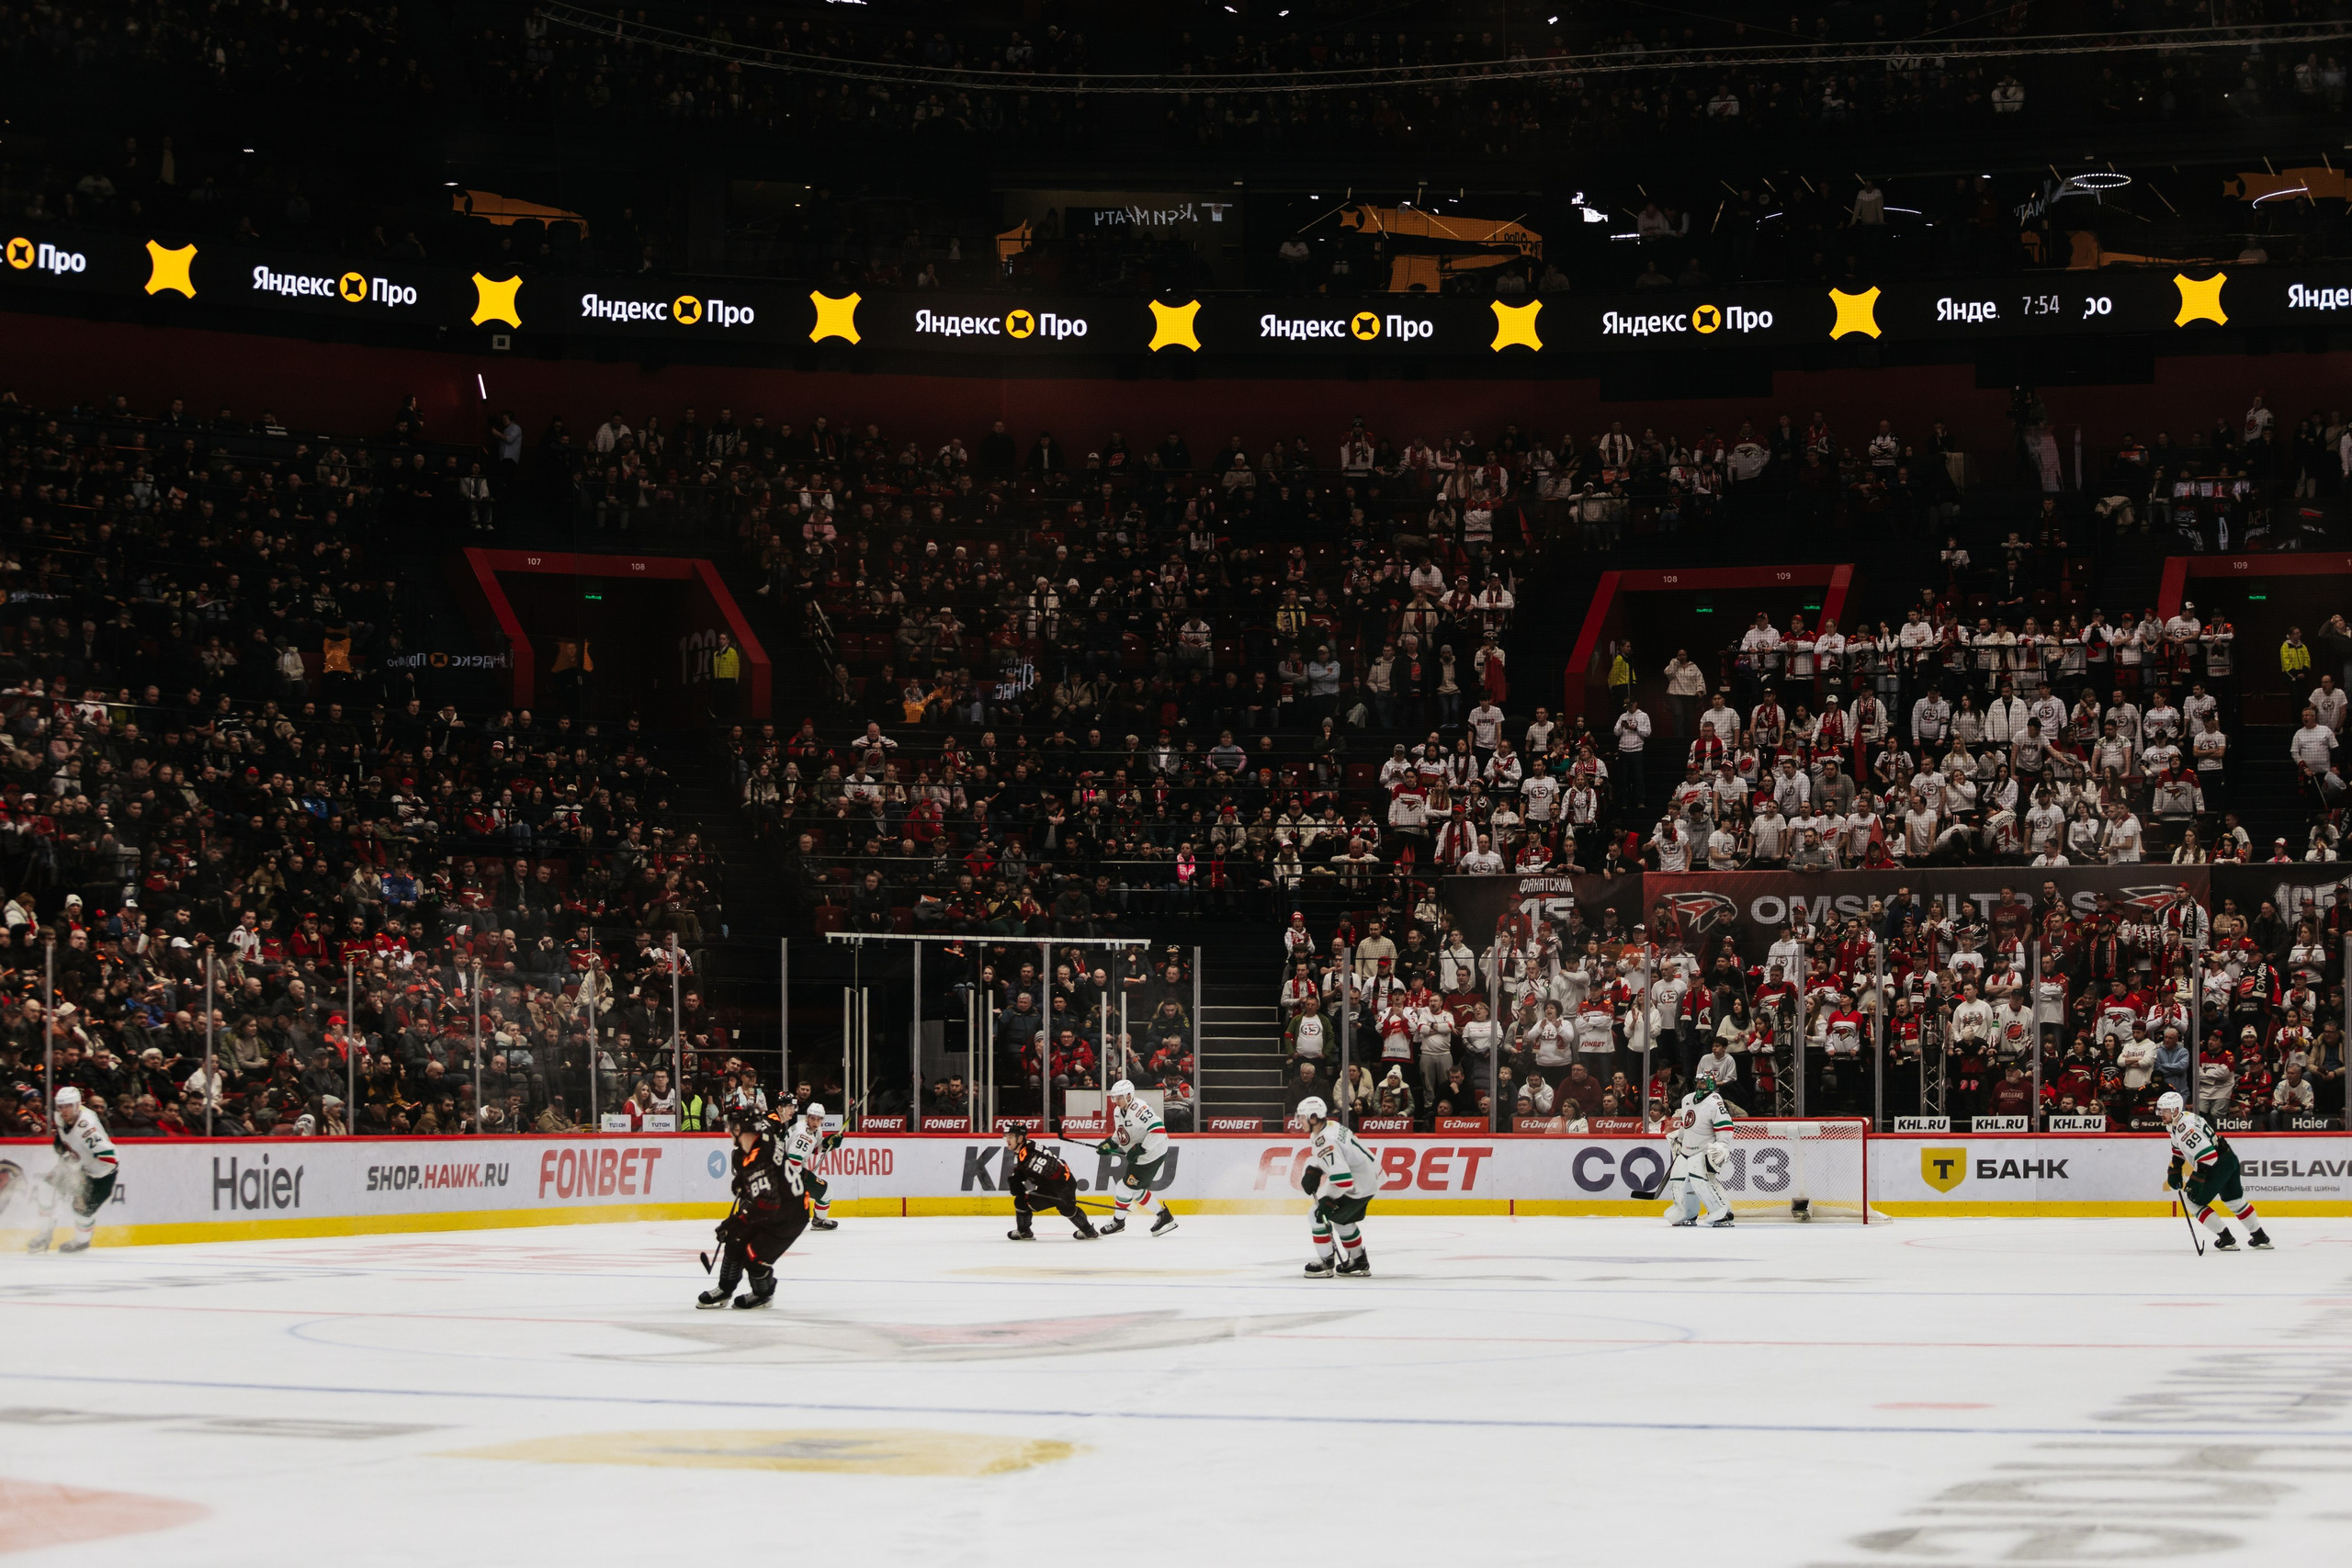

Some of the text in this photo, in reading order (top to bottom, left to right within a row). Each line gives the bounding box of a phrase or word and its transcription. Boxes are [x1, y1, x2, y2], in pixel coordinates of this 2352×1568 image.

[38, 243, 86, 275] Про
[253, 265, 417, 308] Яндекс Про
[2022, 295, 2060, 315] 7:54
[2288, 284, 2352, 310] Янде
[582, 293, 755, 328] Яндекс Про
[1936, 297, 2000, 323] Янде
[915, 309, 1088, 341] Яндекс Про
[1260, 314, 1434, 342] Яндекс Про
[1602, 306, 1773, 337] Яндекс Про
[526, 557, 542, 566] 107
[630, 563, 646, 571] 108
[2233, 561, 2248, 570] 109
[1662, 575, 1678, 583] 108
[1776, 572, 1791, 581] 109
[1519, 875, 1574, 894] ФАНАТСКИЙ
[2271, 873, 2352, 931] 195
[2256, 963, 2267, 992] OMSK
[862, 1118, 903, 1129] FONBET
[924, 1119, 967, 1129] FONBET
[1061, 1119, 1107, 1130] FONBET
[1125, 1120, 1133, 1128] C
[1138, 1109, 1154, 1123] 53
[1211, 1119, 1260, 1130] FONBET
[1363, 1119, 1410, 1130] FONBET
[1897, 1118, 1948, 1131] KHL.RU
[1974, 1118, 2026, 1131] KHL.RU
[2052, 1117, 2103, 1130] KHL.RU
[2216, 1116, 2253, 1130] Haier
[2291, 1116, 2328, 1130] Haier
[796, 1139, 809, 1152] 95
[2186, 1132, 2202, 1149] 89
[1032, 1156, 1047, 1174] 96
[1322, 1152, 1335, 1168] 17
[1976, 1158, 2069, 1179] БАНК
[367, 1163, 510, 1191] SHOP.HAWK.RU
[538, 1147, 662, 1200] FONBET
[1253, 1146, 1494, 1192] FOBET
[212, 1153, 305, 1211] Haier
[750, 1177, 772, 1198] 84
